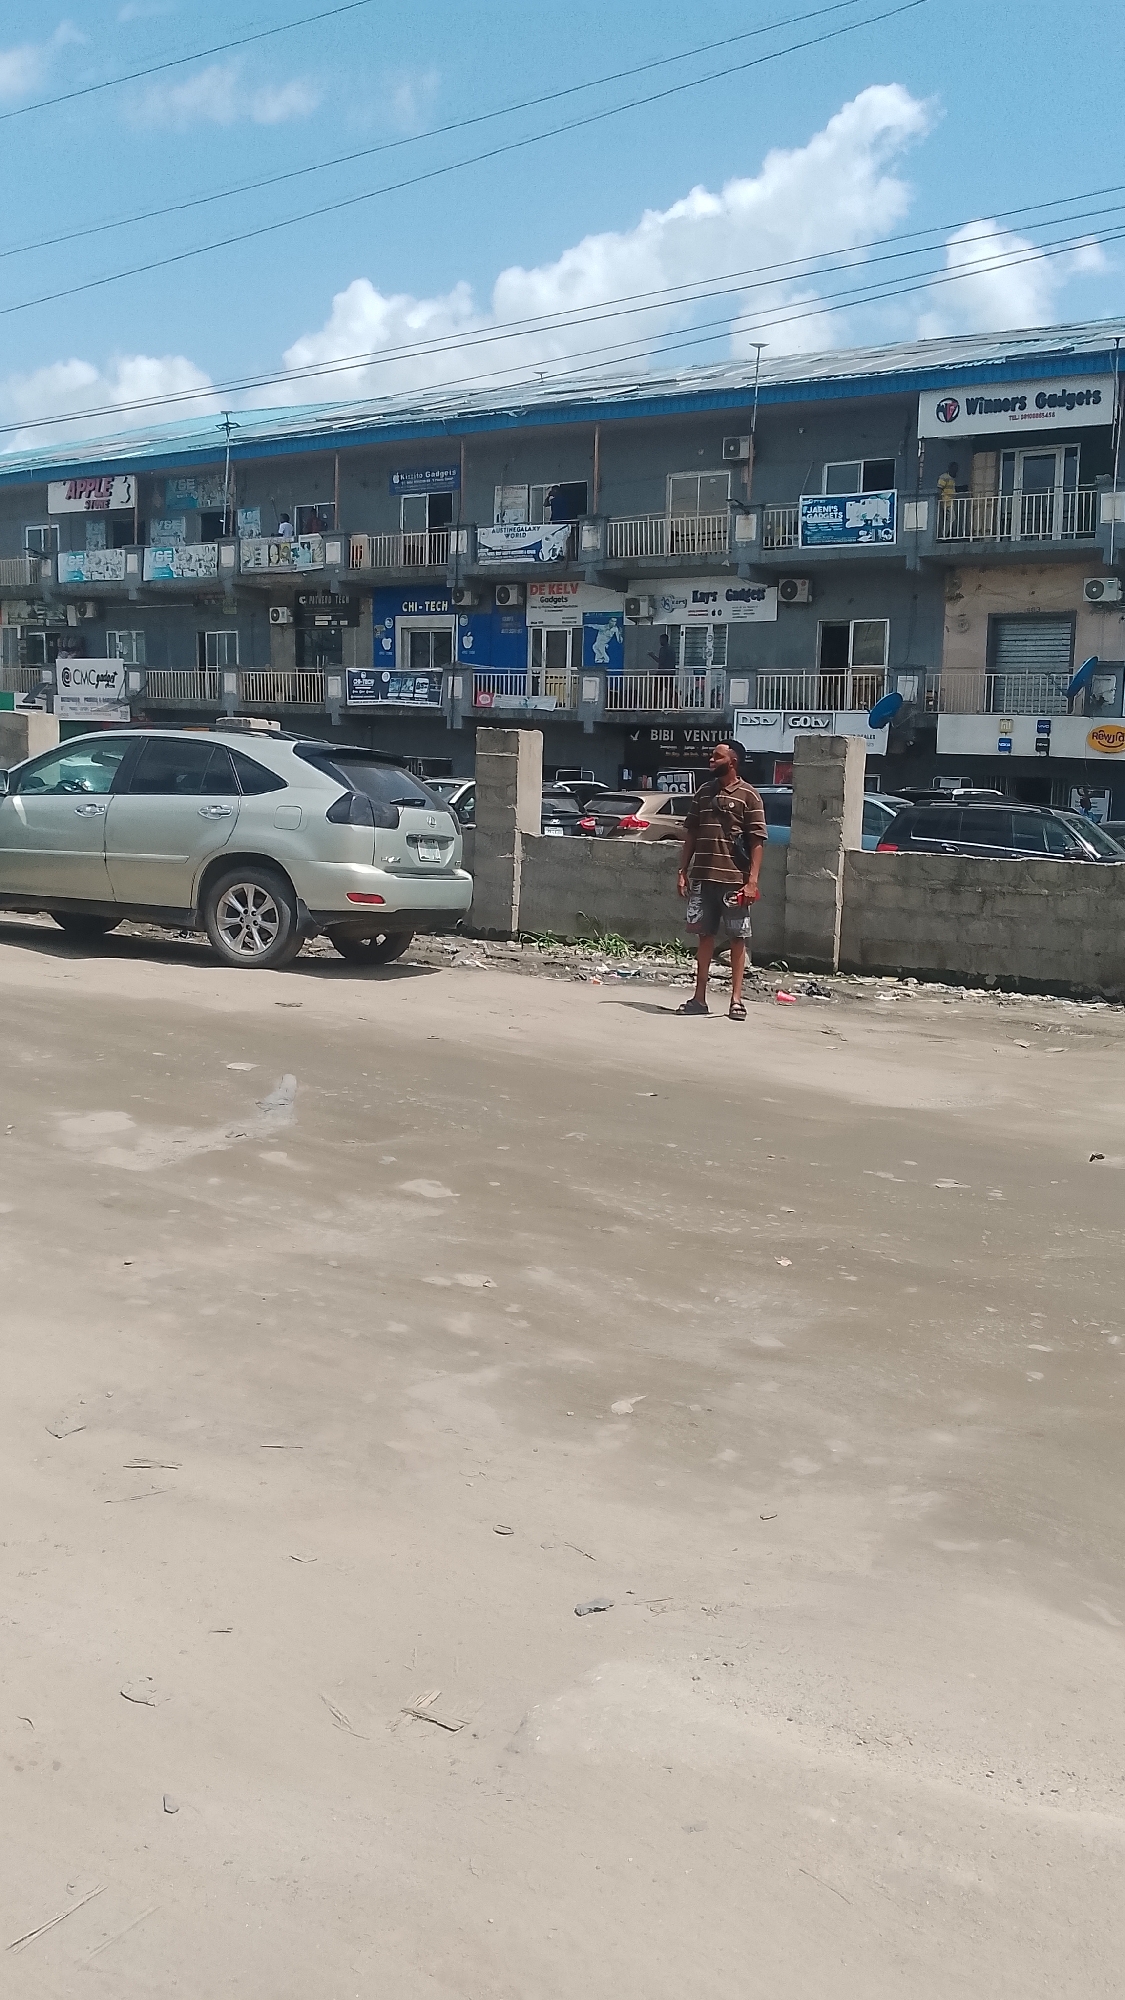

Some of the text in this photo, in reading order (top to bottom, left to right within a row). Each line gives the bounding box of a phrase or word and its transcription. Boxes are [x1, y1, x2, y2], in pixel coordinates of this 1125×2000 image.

[966, 389, 1102, 416] Winners Gadgets
[65, 478, 114, 500] APPLE
[807, 505, 839, 514] JAENI'S
[807, 512, 844, 520] GADGETS
[491, 526, 541, 534] AUSTINEGALAXY
[530, 582, 579, 595] DE KELV
[335, 595, 350, 604] TECH
[539, 596, 569, 605] Gadgets
[650, 729, 674, 742] BIBI
